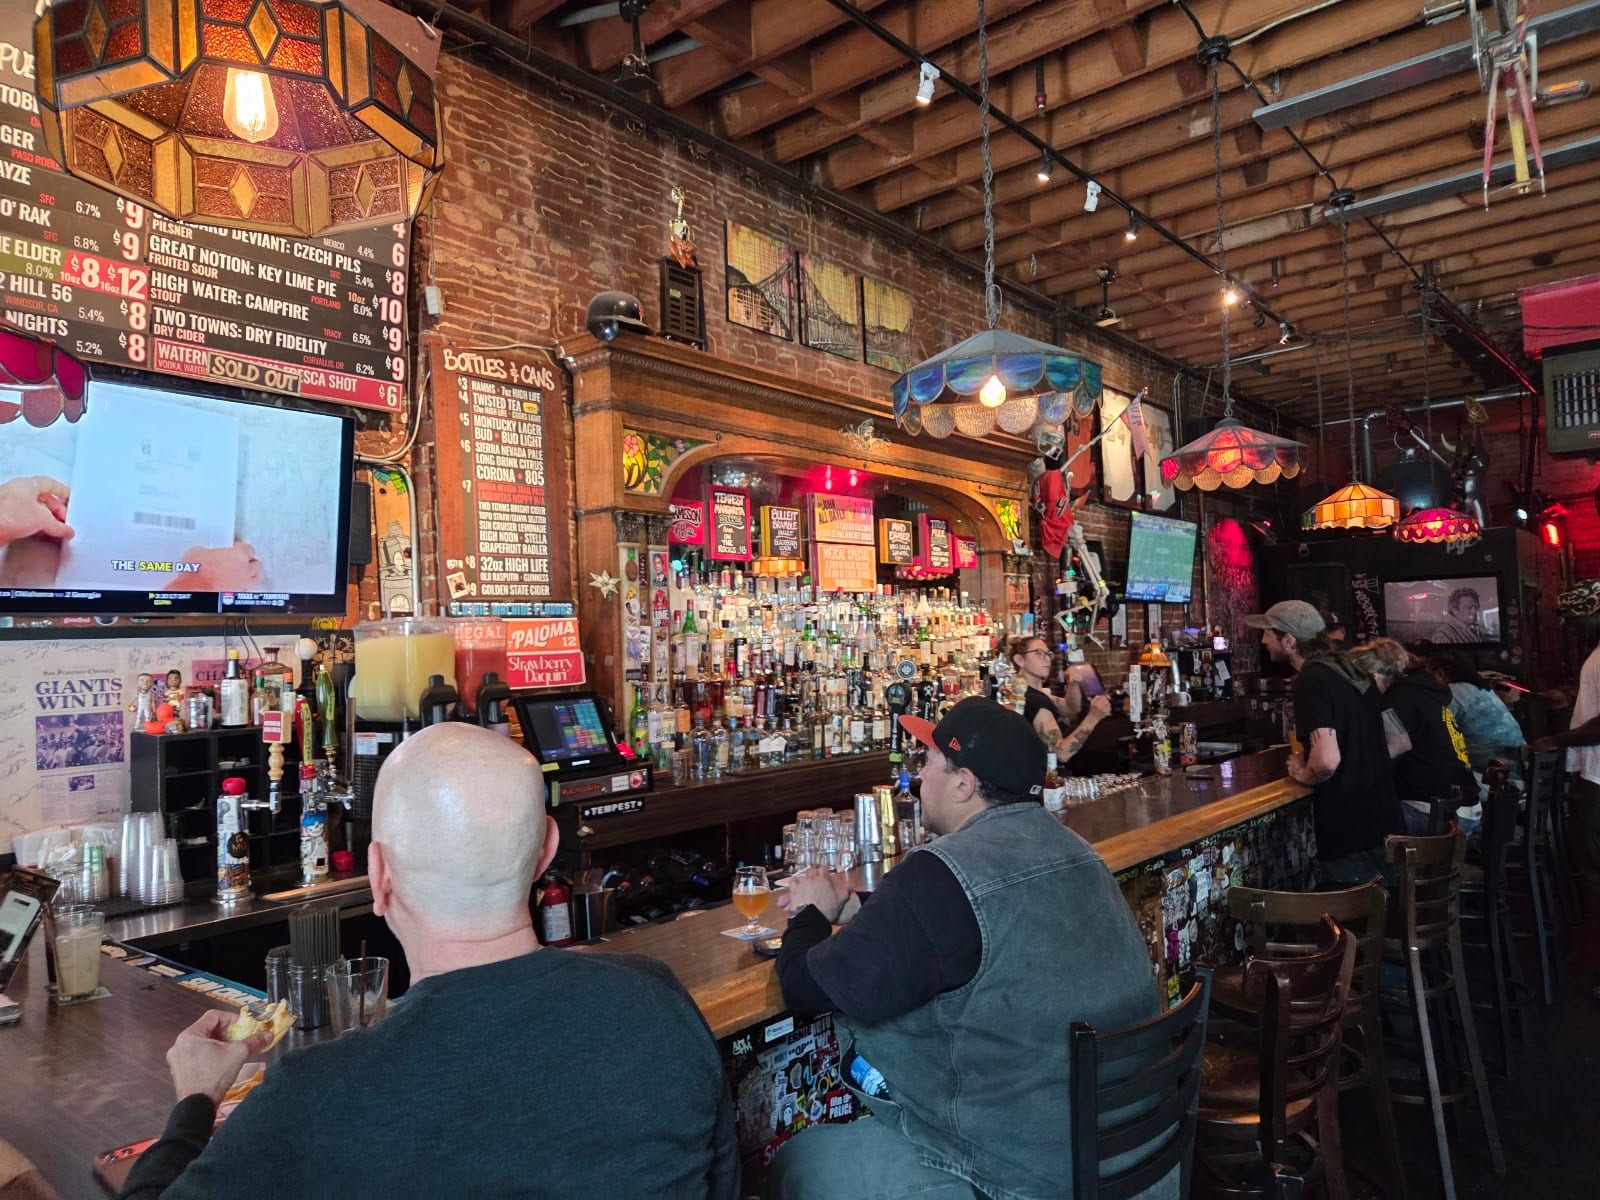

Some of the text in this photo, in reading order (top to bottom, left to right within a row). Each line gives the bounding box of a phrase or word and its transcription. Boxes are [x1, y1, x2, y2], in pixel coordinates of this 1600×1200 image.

[39, 193, 56, 206] SFC
[75, 200, 101, 218] 6.7%
[19, 202, 51, 227] RAK
[116, 196, 144, 229] $9
[43, 230, 58, 242] SFC
[152, 218, 193, 240] PILSNER
[14, 239, 62, 266] ELDER
[73, 235, 100, 252] 6.8%
[113, 229, 140, 262] $9
[231, 229, 361, 274] DEVIANT: CZECH PILS
[323, 236, 345, 251] MEXICO
[357, 245, 375, 259] 4.4%
[25, 262, 54, 280] 8.0%
[70, 254, 100, 288] $8
[149, 251, 219, 280] FRUITED SOUR
[149, 234, 337, 298] GREAT NOTION: KEY LIME PIE
[60, 271, 82, 286] 10oz
[100, 281, 121, 295] 16oz
[107, 263, 148, 301] $12
[355, 274, 375, 289] 5.4%
[385, 268, 405, 295] $8
[9, 274, 73, 303] HILL 56
[150, 287, 182, 304] STOUT
[151, 270, 309, 321] HIGH WATER: CAMPFIRE
[347, 291, 367, 305] 10oz
[47, 302, 59, 314] CA
[78, 306, 105, 323] 5.4%
[119, 299, 147, 331] $8
[353, 303, 373, 318] 6.0%
[372, 294, 403, 325] $10
[153, 306, 328, 356] TWO TOWNS: DRY FIDELITY
[153, 323, 205, 344] DRY CIDER
[323, 327, 342, 339] TRACY
[352, 332, 372, 346] 6.5%
[382, 325, 402, 352] $9
[76, 340, 103, 356] 5.2%
[118, 331, 146, 363] $8
[211, 356, 260, 382] SOLD
[264, 369, 299, 391] OUT
[355, 362, 375, 376] 6.2%
[385, 355, 405, 381] $9
[520, 364, 556, 391] CANS
[328, 374, 358, 393] SHOT
[471, 380, 496, 394] HAMMS
[528, 391, 541, 402] LIFE
[378, 383, 398, 407] $6
[472, 392, 522, 412] TWISTED TEA
[473, 414, 542, 437] MONTUCKY LAGER
[474, 427, 543, 449] BUD BUD LIGHT
[475, 441, 544, 461] SIERRA NEVADA PALE
[475, 453, 544, 472] LONG DRINK CITRUS
[476, 464, 545, 487] CORONA 805
[770, 508, 799, 521] BULLEIT
[772, 520, 798, 530] BRAMBLE
[480, 530, 498, 542] HIGH
[524, 533, 548, 545] STELLA
[479, 541, 548, 555] GRAPEFRUIT RADLER
[111, 560, 201, 573] THE SAME DAY
[480, 556, 503, 571] 32oz
[504, 558, 529, 572] HIGH
[530, 558, 549, 573] LIFE
[481, 584, 550, 596] GOLDEN STATE CIDER
[511, 620, 575, 650] PALOMA
[562, 635, 577, 647] 12
[508, 655, 573, 673] Strawberry
[35, 678, 123, 695] GIANTS
[37, 692, 122, 710] WIN IT!
[590, 800, 637, 816] TEMPEST
